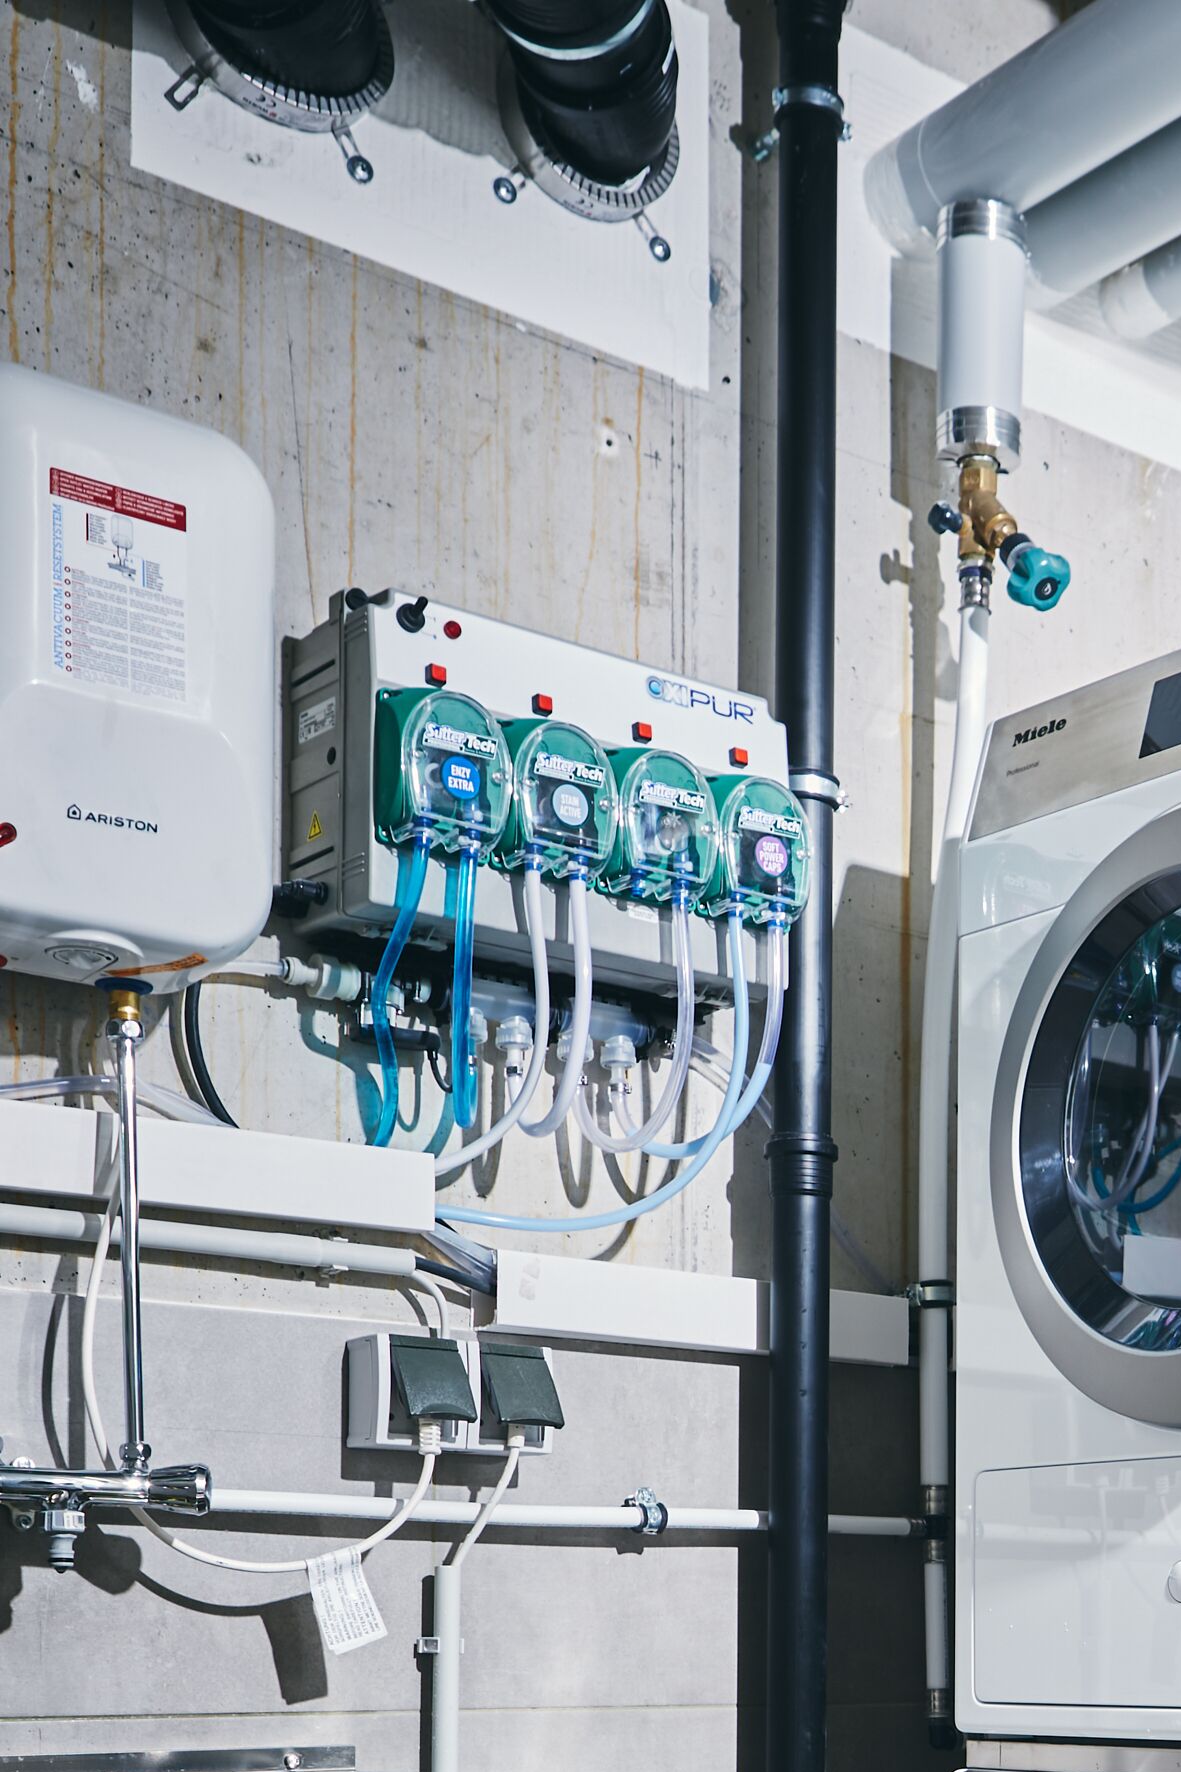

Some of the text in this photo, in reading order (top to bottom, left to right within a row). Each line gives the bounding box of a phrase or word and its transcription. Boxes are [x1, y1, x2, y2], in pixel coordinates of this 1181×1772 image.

[52, 503, 64, 669] ANTIVACUUM RESETSYSTEM
[425, 722, 465, 745] Sutter
[465, 735, 496, 754] Tech
[1012, 718, 1067, 747] Miele
[451, 764, 471, 779] ENZY
[536, 752, 575, 774] Sutter
[575, 763, 603, 782] Tech
[448, 776, 474, 793] EXTRA
[640, 780, 678, 801] Sutter
[678, 790, 704, 808] Tech
[85, 812, 158, 833] ARISTON
[740, 806, 775, 827] Sutter
[775, 816, 801, 834] Tech
[759, 850, 784, 863] POWER
[762, 840, 779, 853] SOFT
[763, 861, 783, 873] CAPS
